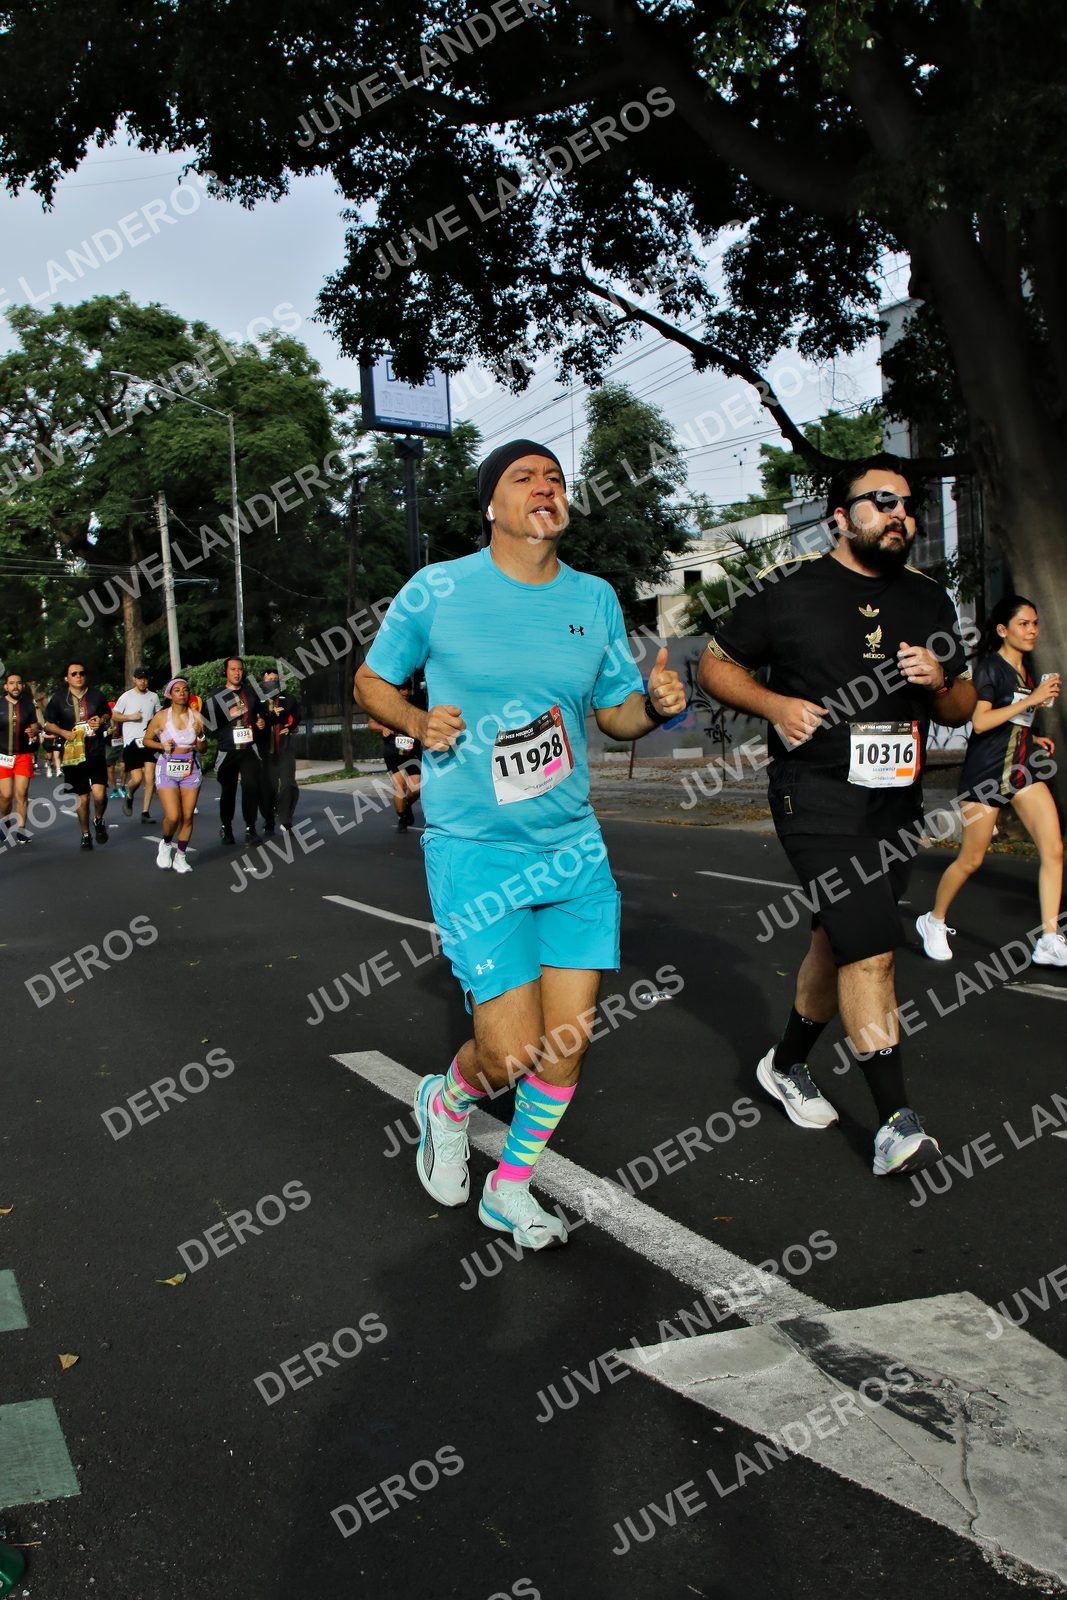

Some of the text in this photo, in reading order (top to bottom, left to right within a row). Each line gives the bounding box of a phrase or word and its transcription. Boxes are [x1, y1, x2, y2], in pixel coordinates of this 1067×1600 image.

[495, 733, 563, 777] 11928
[855, 743, 913, 765] 10316
[168, 762, 189, 772] 12412
